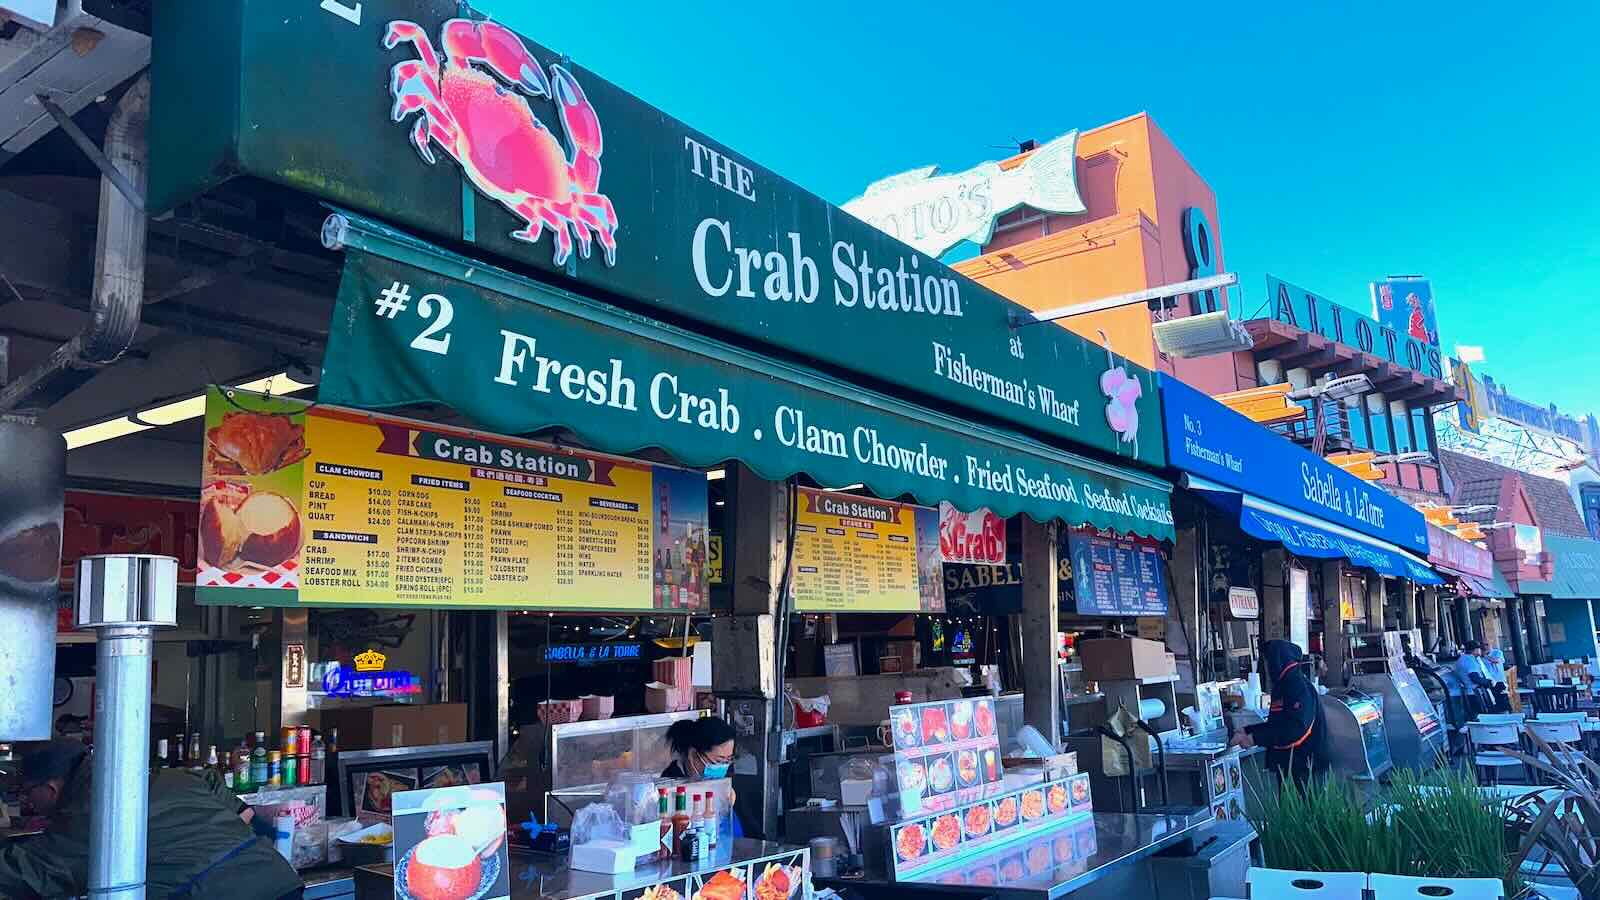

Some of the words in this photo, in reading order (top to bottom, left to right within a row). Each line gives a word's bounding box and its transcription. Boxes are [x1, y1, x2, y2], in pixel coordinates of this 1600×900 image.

[685, 136, 756, 202] THE
[692, 217, 820, 304] Crab
[832, 240, 963, 317] Station
[374, 280, 455, 356] #2
[1276, 282, 1443, 379] ALIOTO'S
[1009, 335, 1025, 360] at
[932, 341, 1035, 411] Fisherman's
[1038, 384, 1080, 427] Wharf
[494, 329, 638, 412] Fresh
[650, 371, 741, 434] Crab
[774, 405, 849, 458] Clam
[853, 426, 948, 481] Chowder
[966, 455, 1012, 494] Fried
[1018, 467, 1079, 505] Seafood
[1083, 483, 1135, 516] Seafood
[1133, 494, 1174, 526] Cocktails
[434, 438, 493, 465] Crab
[500, 448, 579, 478] Station
[1184, 436, 1225, 469] Fisherman's
[1225, 452, 1243, 473] Wharf
[319, 465, 342, 476] CLAM
[343, 467, 381, 479] CHOWDER
[309, 480, 326, 489] CUP
[418, 477, 441, 487] FRIED
[441, 480, 464, 489] ITEMS
[309, 491, 336, 501] BREAD
[398, 490, 415, 498] CORN
[1301, 460, 1342, 513] Sabella
[1345, 496, 1353, 517] &
[1354, 488, 1385, 530] LaTorre
[308, 501, 327, 511] PINT
[415, 501, 432, 509] CAKE
[824, 499, 850, 514] Crab
[851, 503, 887, 521] Station
[308, 511, 336, 521] QUART
[323, 532, 369, 542] SANDWICH
[397, 527, 414, 535] CLAM
[952, 518, 998, 562] Crab
[306, 545, 327, 554] CRAB
[305, 556, 336, 565] SHRIMP
[305, 568, 342, 576] SEAFOOD
[342, 569, 357, 577] MIX
[415, 566, 442, 574] CHICKEN
[304, 578, 340, 587] LOBSTER
[341, 579, 361, 588] ROLL
